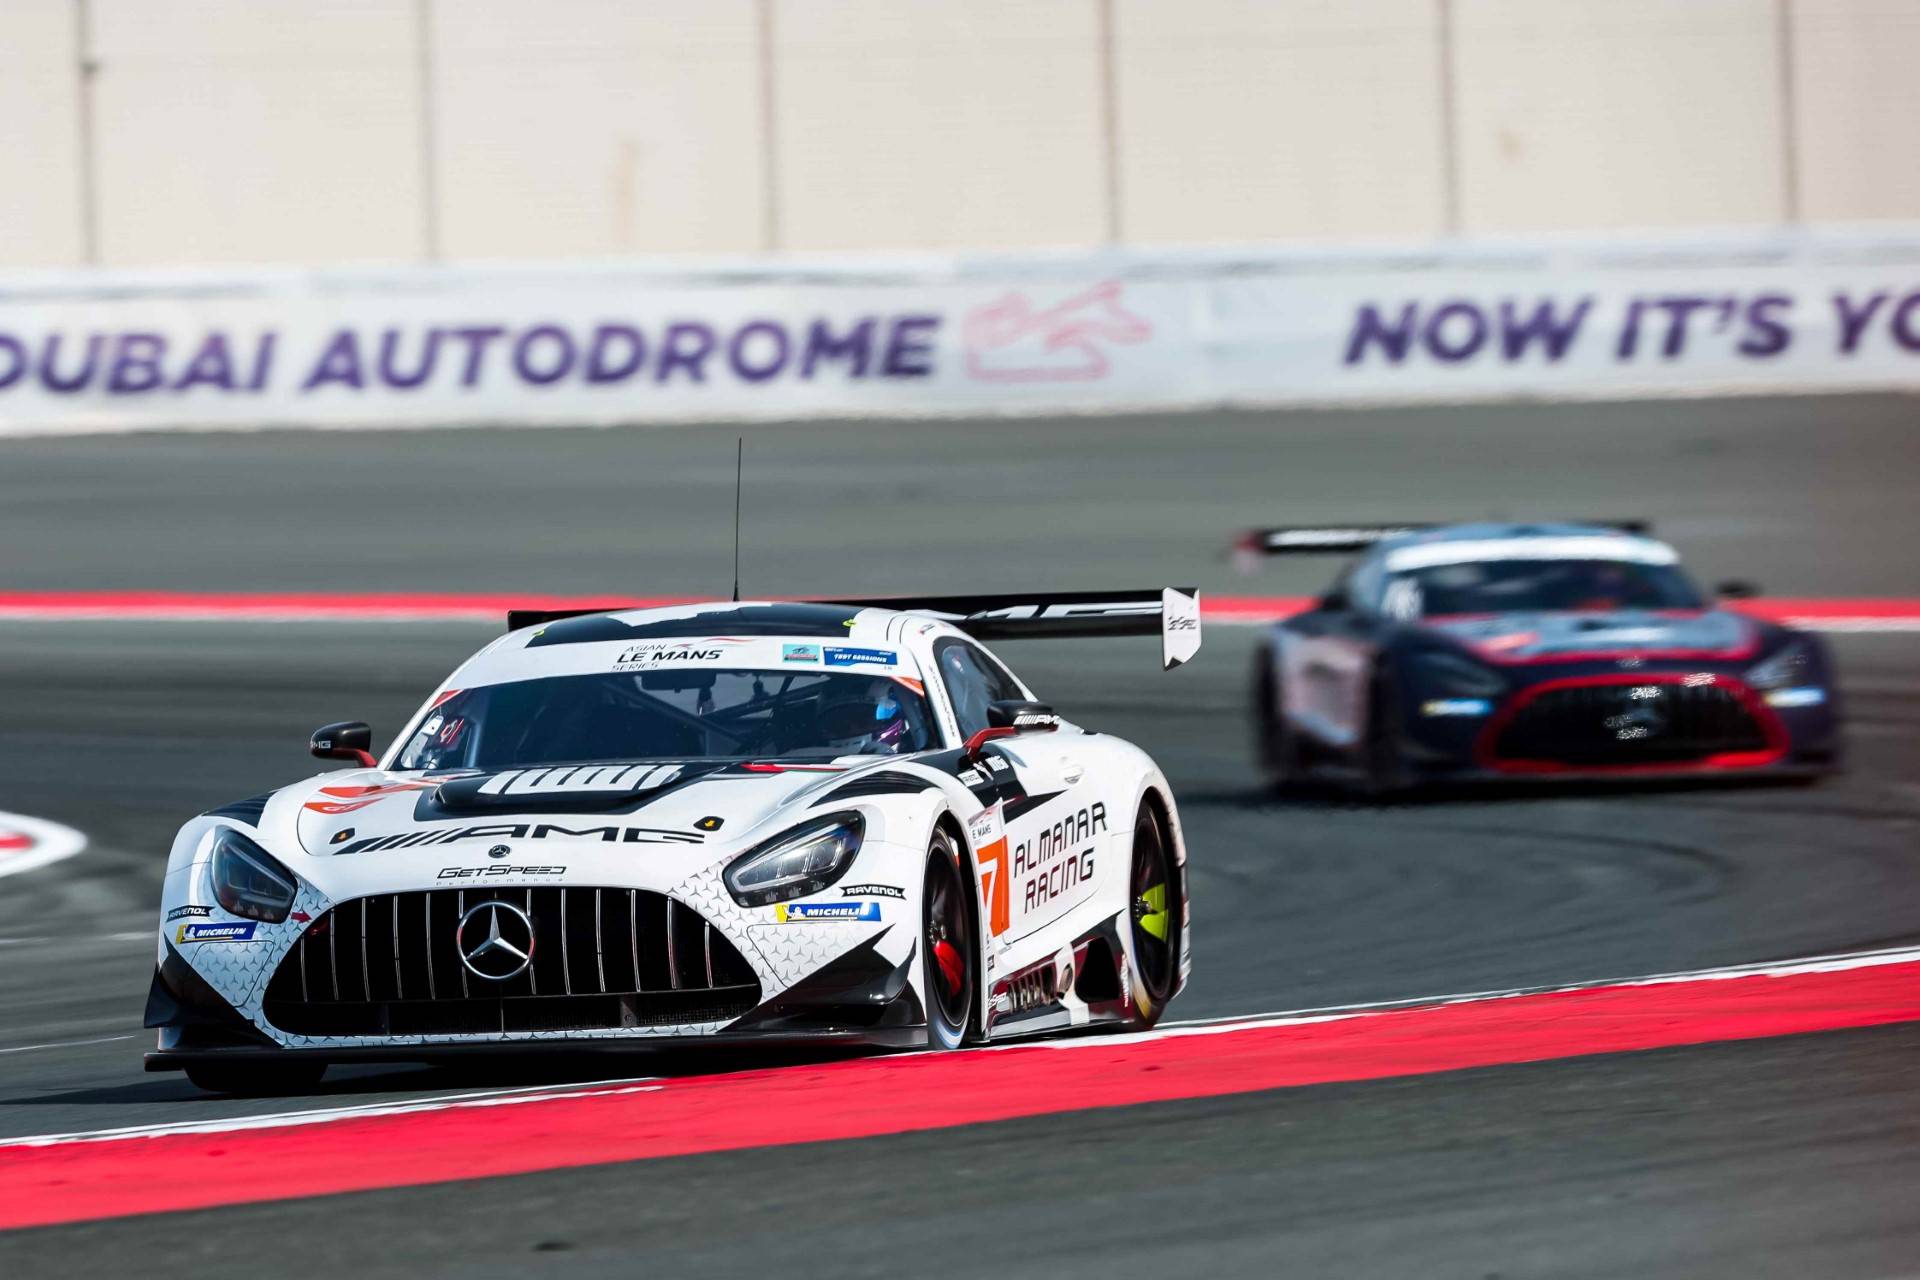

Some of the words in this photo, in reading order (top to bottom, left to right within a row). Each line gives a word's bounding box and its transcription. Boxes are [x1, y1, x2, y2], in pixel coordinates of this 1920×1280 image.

[1343, 299, 1592, 366] NOW
[302, 318, 940, 391] AUTODROME
[625, 644, 667, 653] ASIAN
[617, 651, 647, 663] LE
[651, 649, 723, 661] MANS
[609, 662, 658, 673] SERIES
[1014, 801, 1107, 879] ALMANAR
[1024, 847, 1095, 915] RACING
[845, 885, 903, 897] RAVENOL
[168, 906, 208, 919] RAVENOL
[196, 927, 247, 937] MICHELIN
